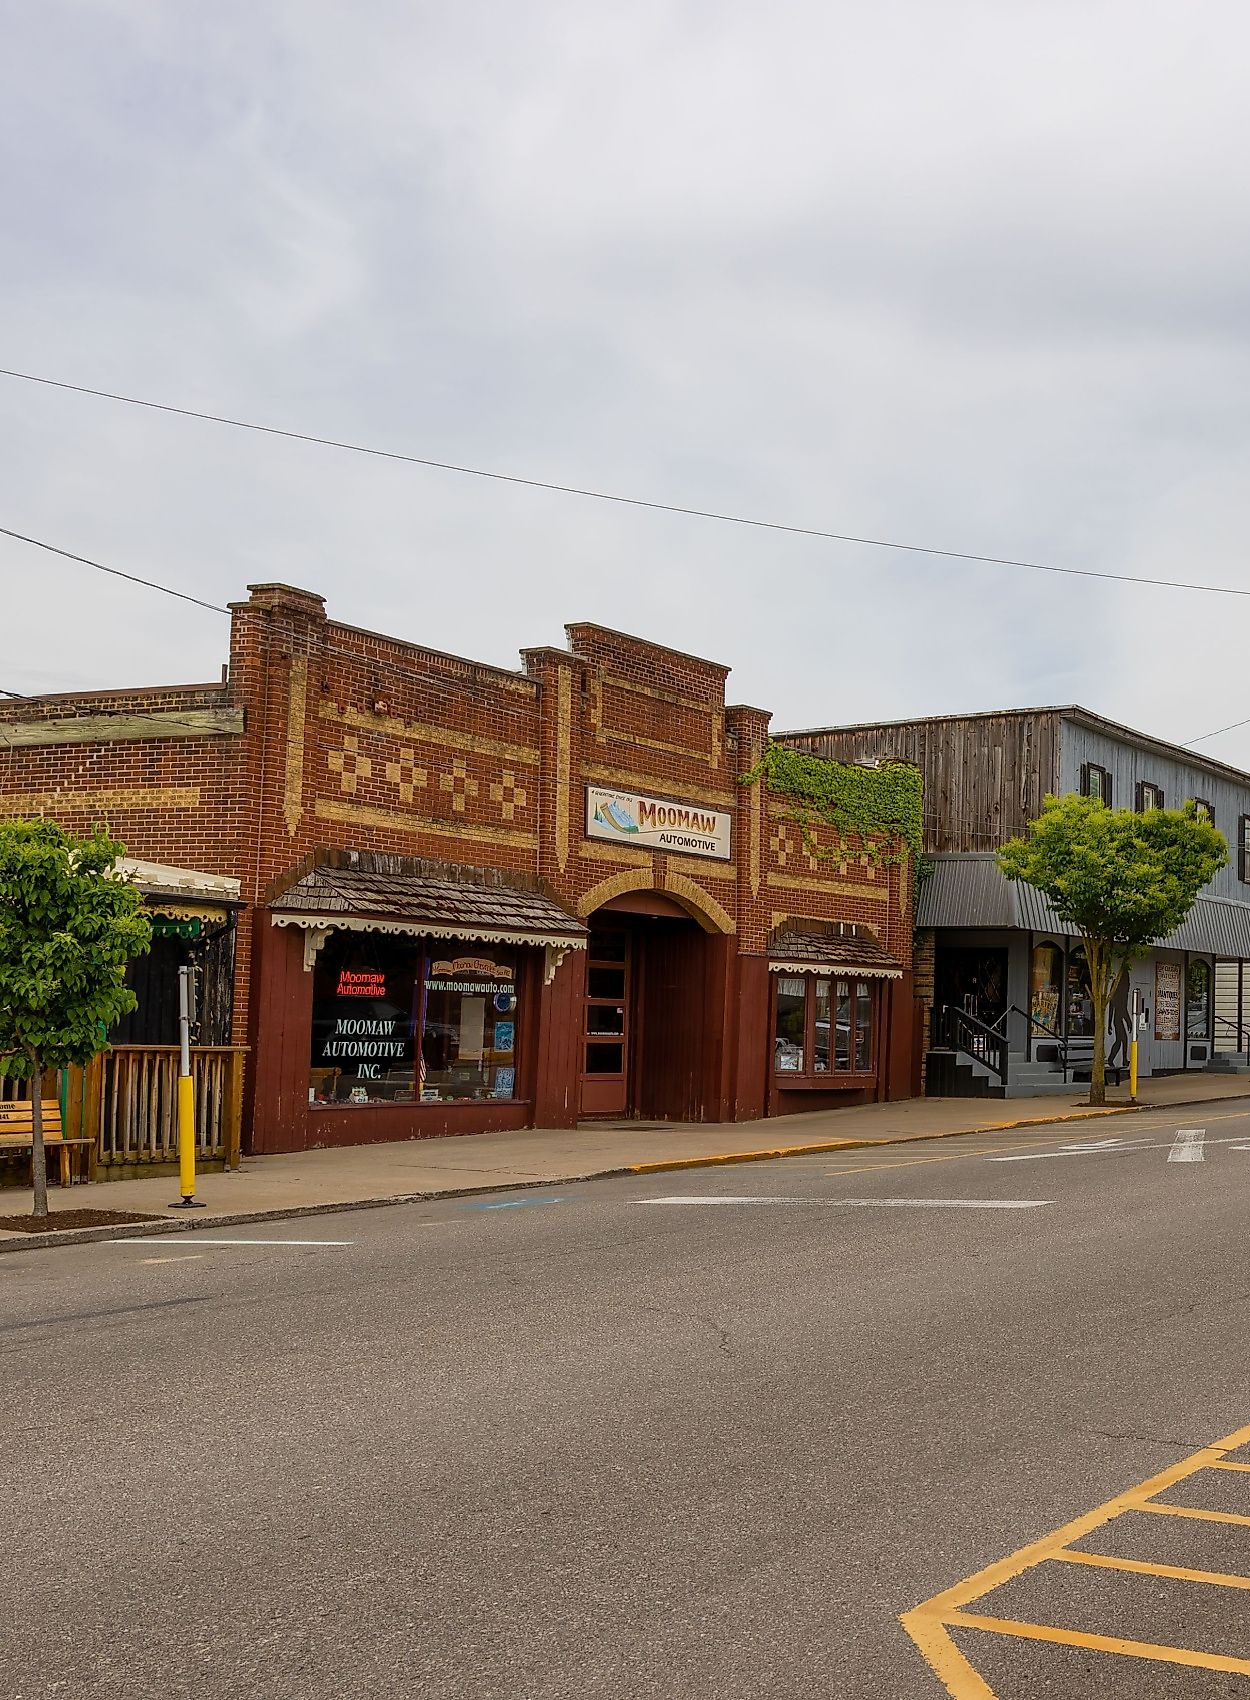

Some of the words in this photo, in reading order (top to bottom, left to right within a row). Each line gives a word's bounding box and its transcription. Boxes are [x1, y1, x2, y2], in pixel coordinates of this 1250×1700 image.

[637, 800, 716, 834] MOOMAW
[659, 833, 716, 852] AUTOMOTIVE
[340, 971, 385, 983] Moomaw
[336, 983, 386, 996] Automotive
[424, 980, 515, 994] www.moomawauto.com
[335, 1018, 396, 1036] MOOMAW
[322, 1041, 405, 1057] AUTOMOTIVE
[356, 1063, 381, 1079] INC.
